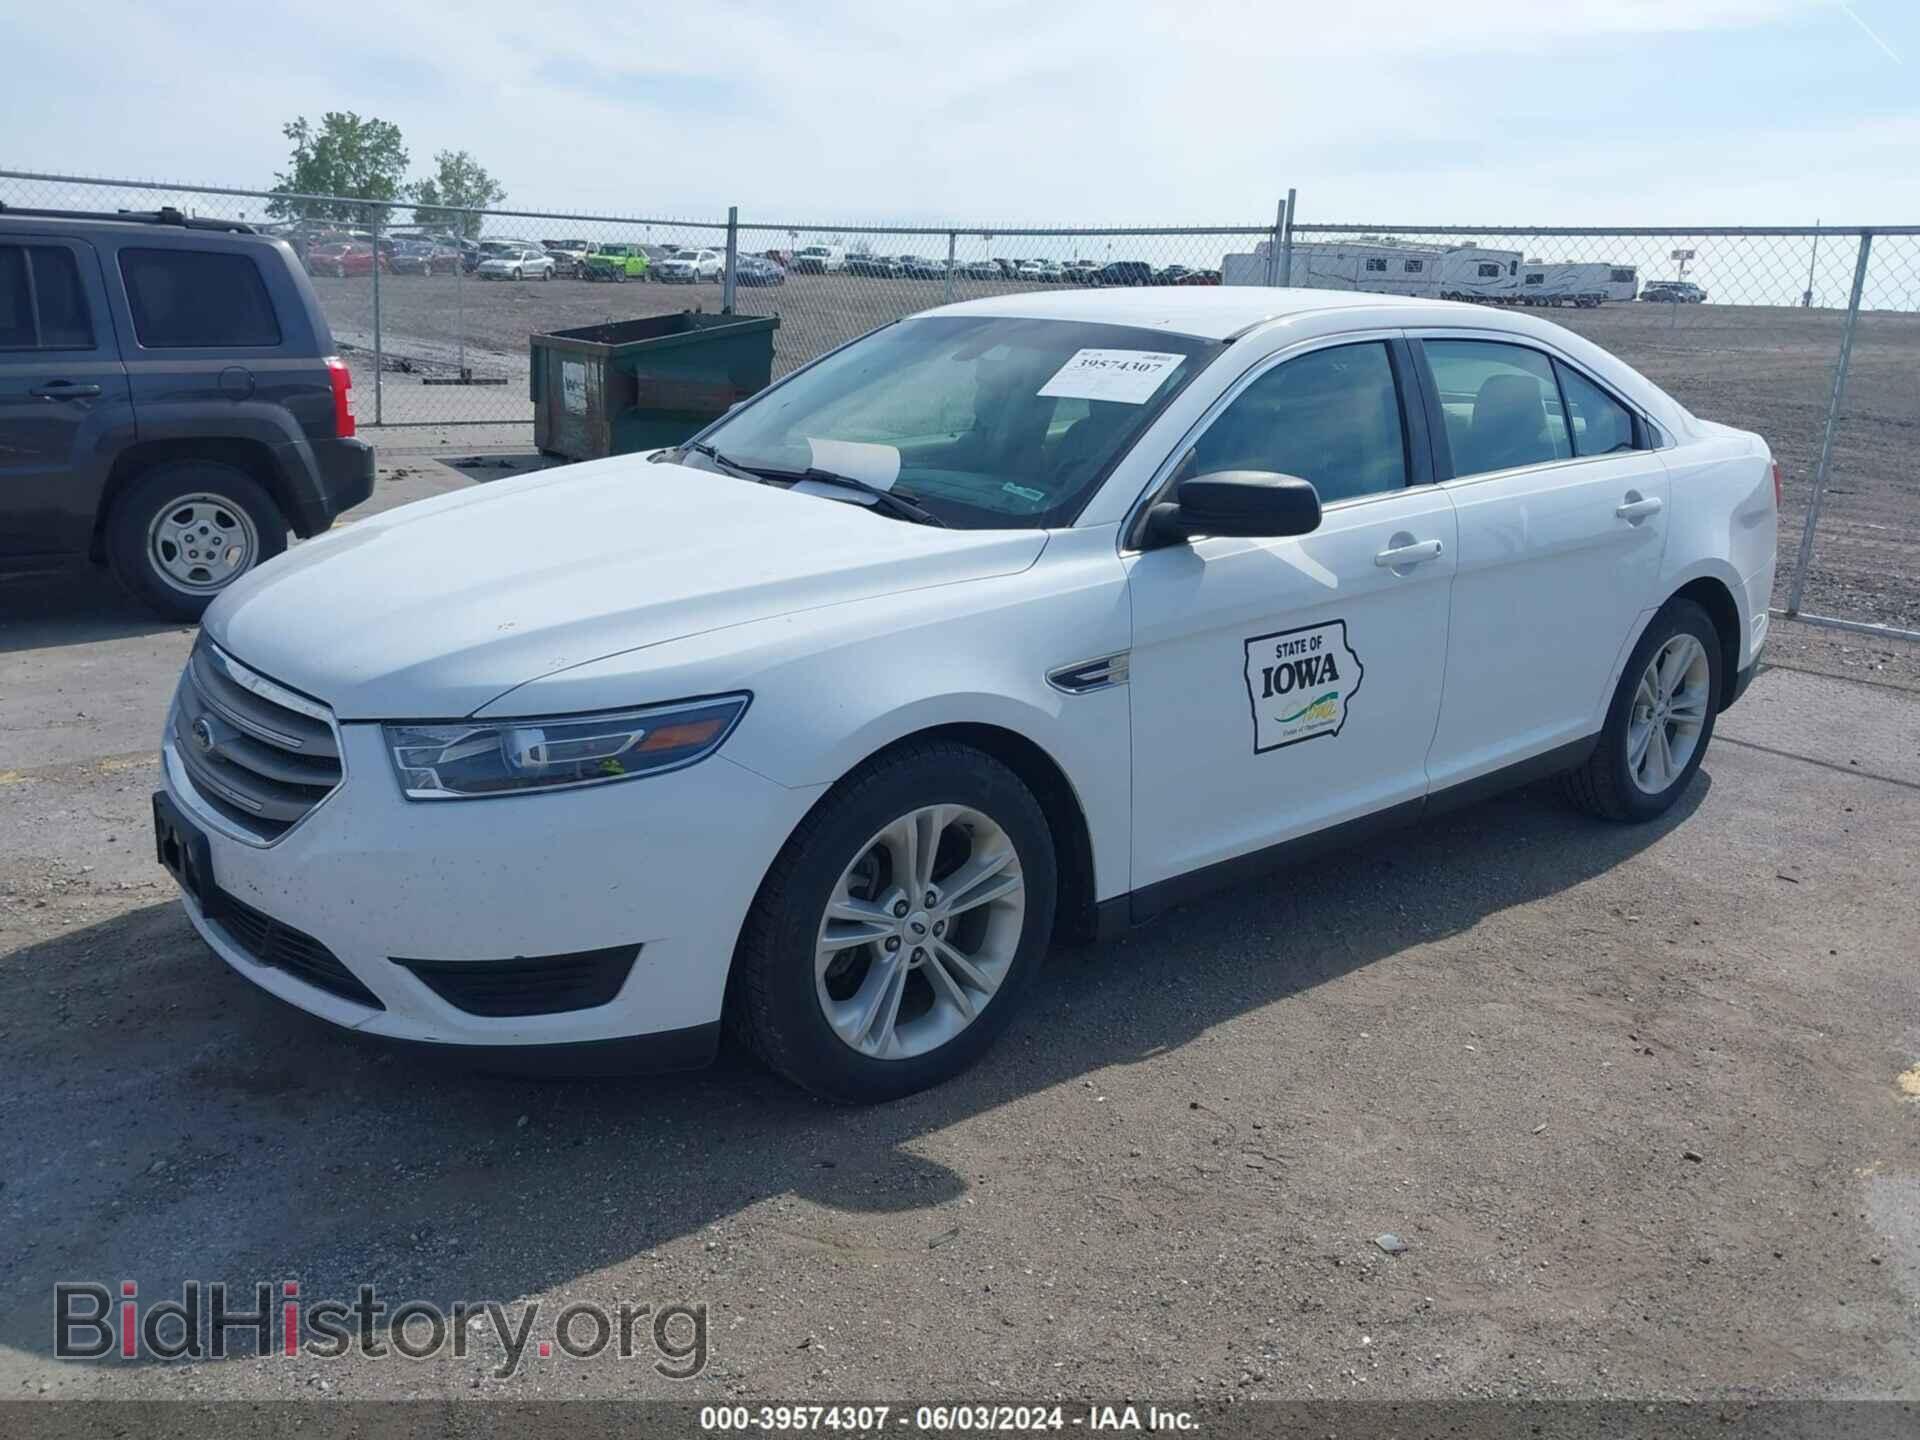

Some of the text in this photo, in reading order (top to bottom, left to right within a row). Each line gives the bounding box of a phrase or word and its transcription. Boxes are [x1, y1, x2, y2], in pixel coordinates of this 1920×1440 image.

[1074, 358, 1163, 373] 39574307
[1276, 635, 1323, 659] STATE OF
[1261, 652, 1340, 699] IOWA
